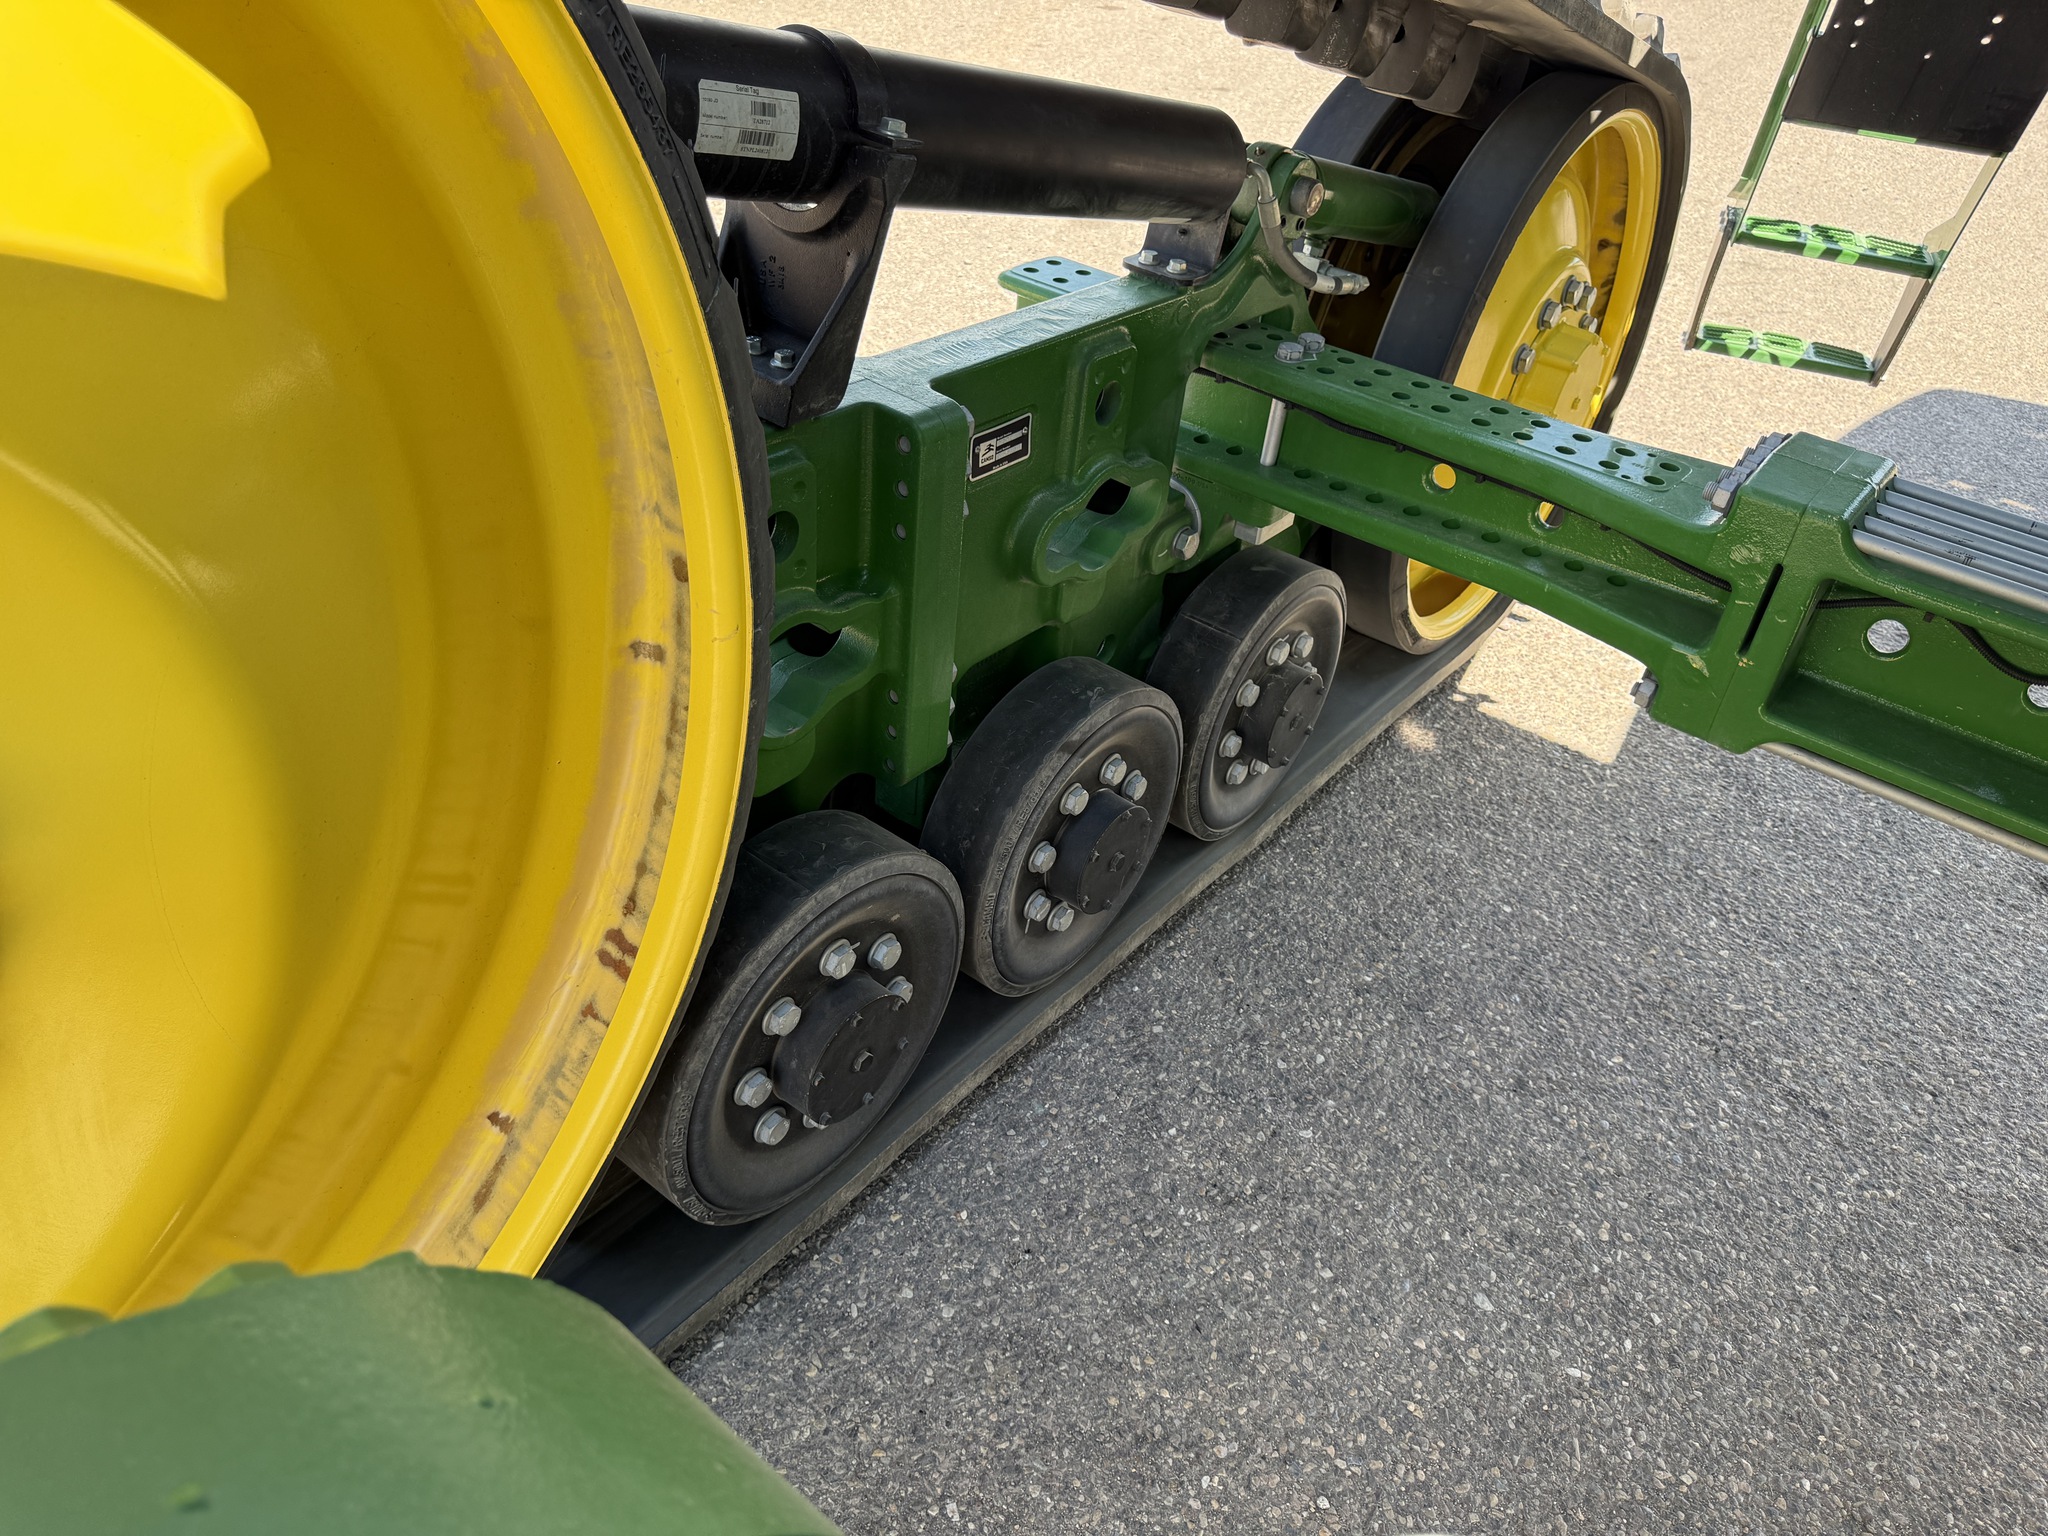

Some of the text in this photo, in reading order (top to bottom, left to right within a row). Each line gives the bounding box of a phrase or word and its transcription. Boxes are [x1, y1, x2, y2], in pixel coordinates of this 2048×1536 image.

[735, 84, 760, 95] Serial Tag
[981, 454, 994, 464] CAMSO
[982, 893, 997, 926] CAMSO
